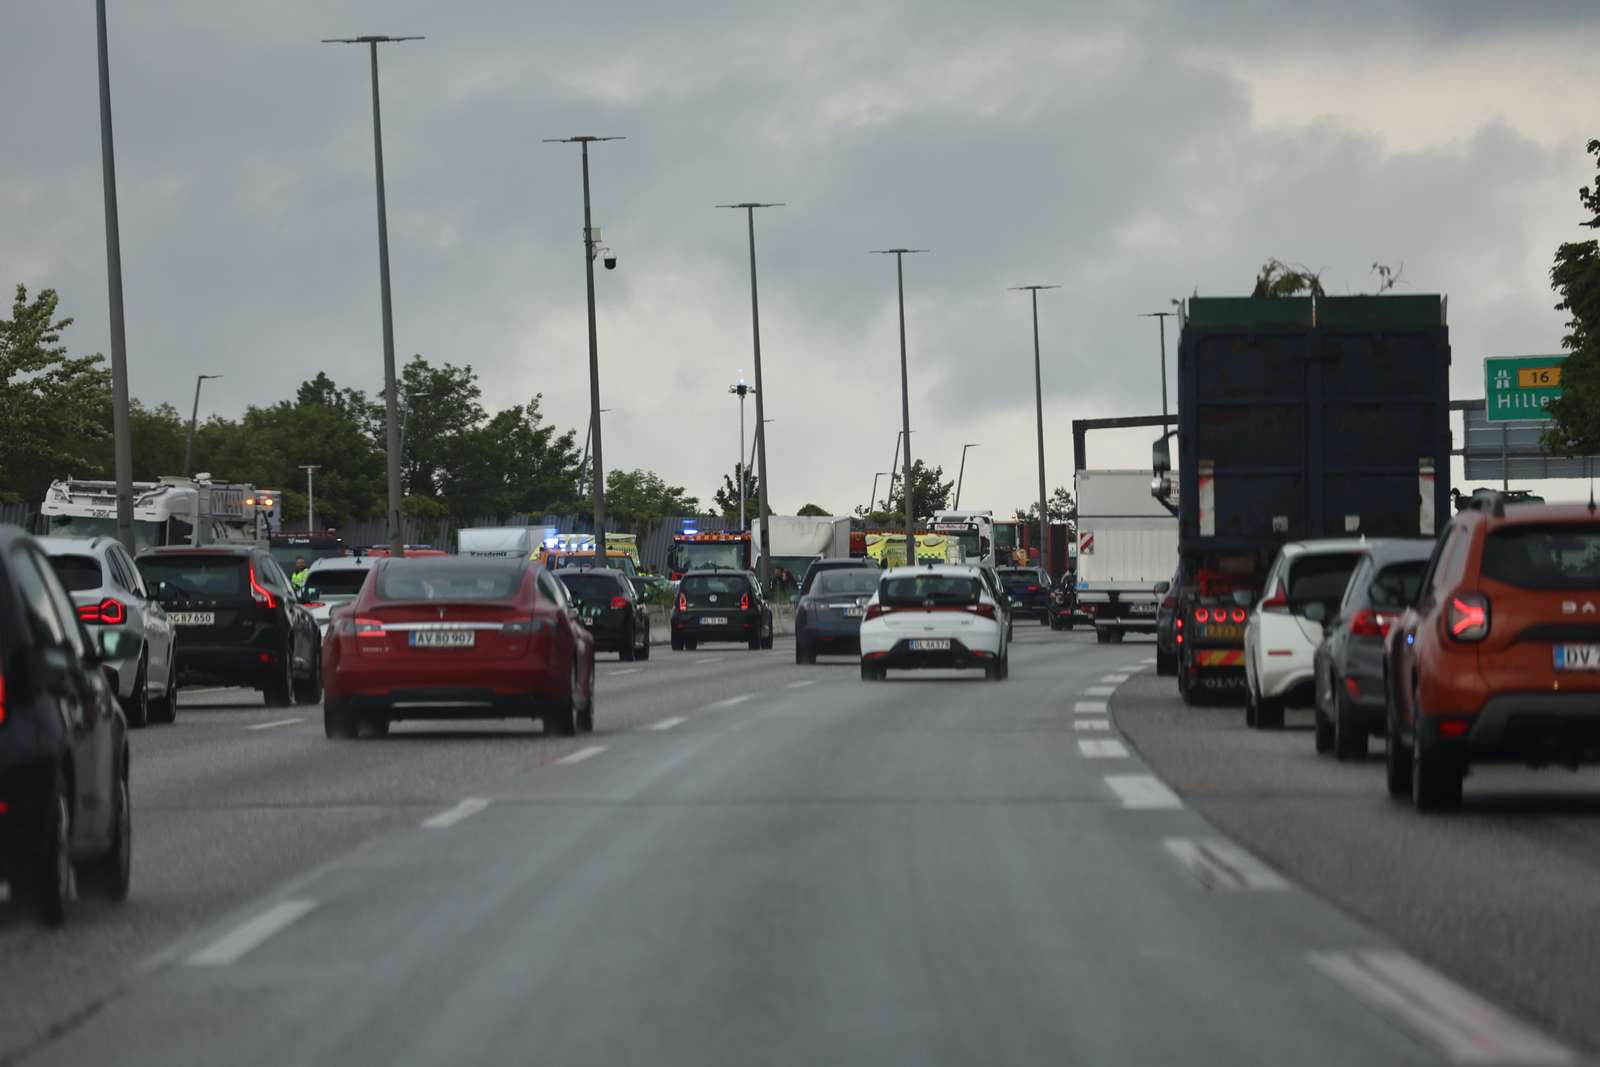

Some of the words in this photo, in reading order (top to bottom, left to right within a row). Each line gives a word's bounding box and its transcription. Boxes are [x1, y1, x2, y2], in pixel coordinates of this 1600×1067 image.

[1532, 372, 1549, 383] 16
[194, 615, 211, 624] 650
[418, 632, 432, 643] AV
[452, 632, 473, 643] 907
[1567, 647, 1590, 663] DV
